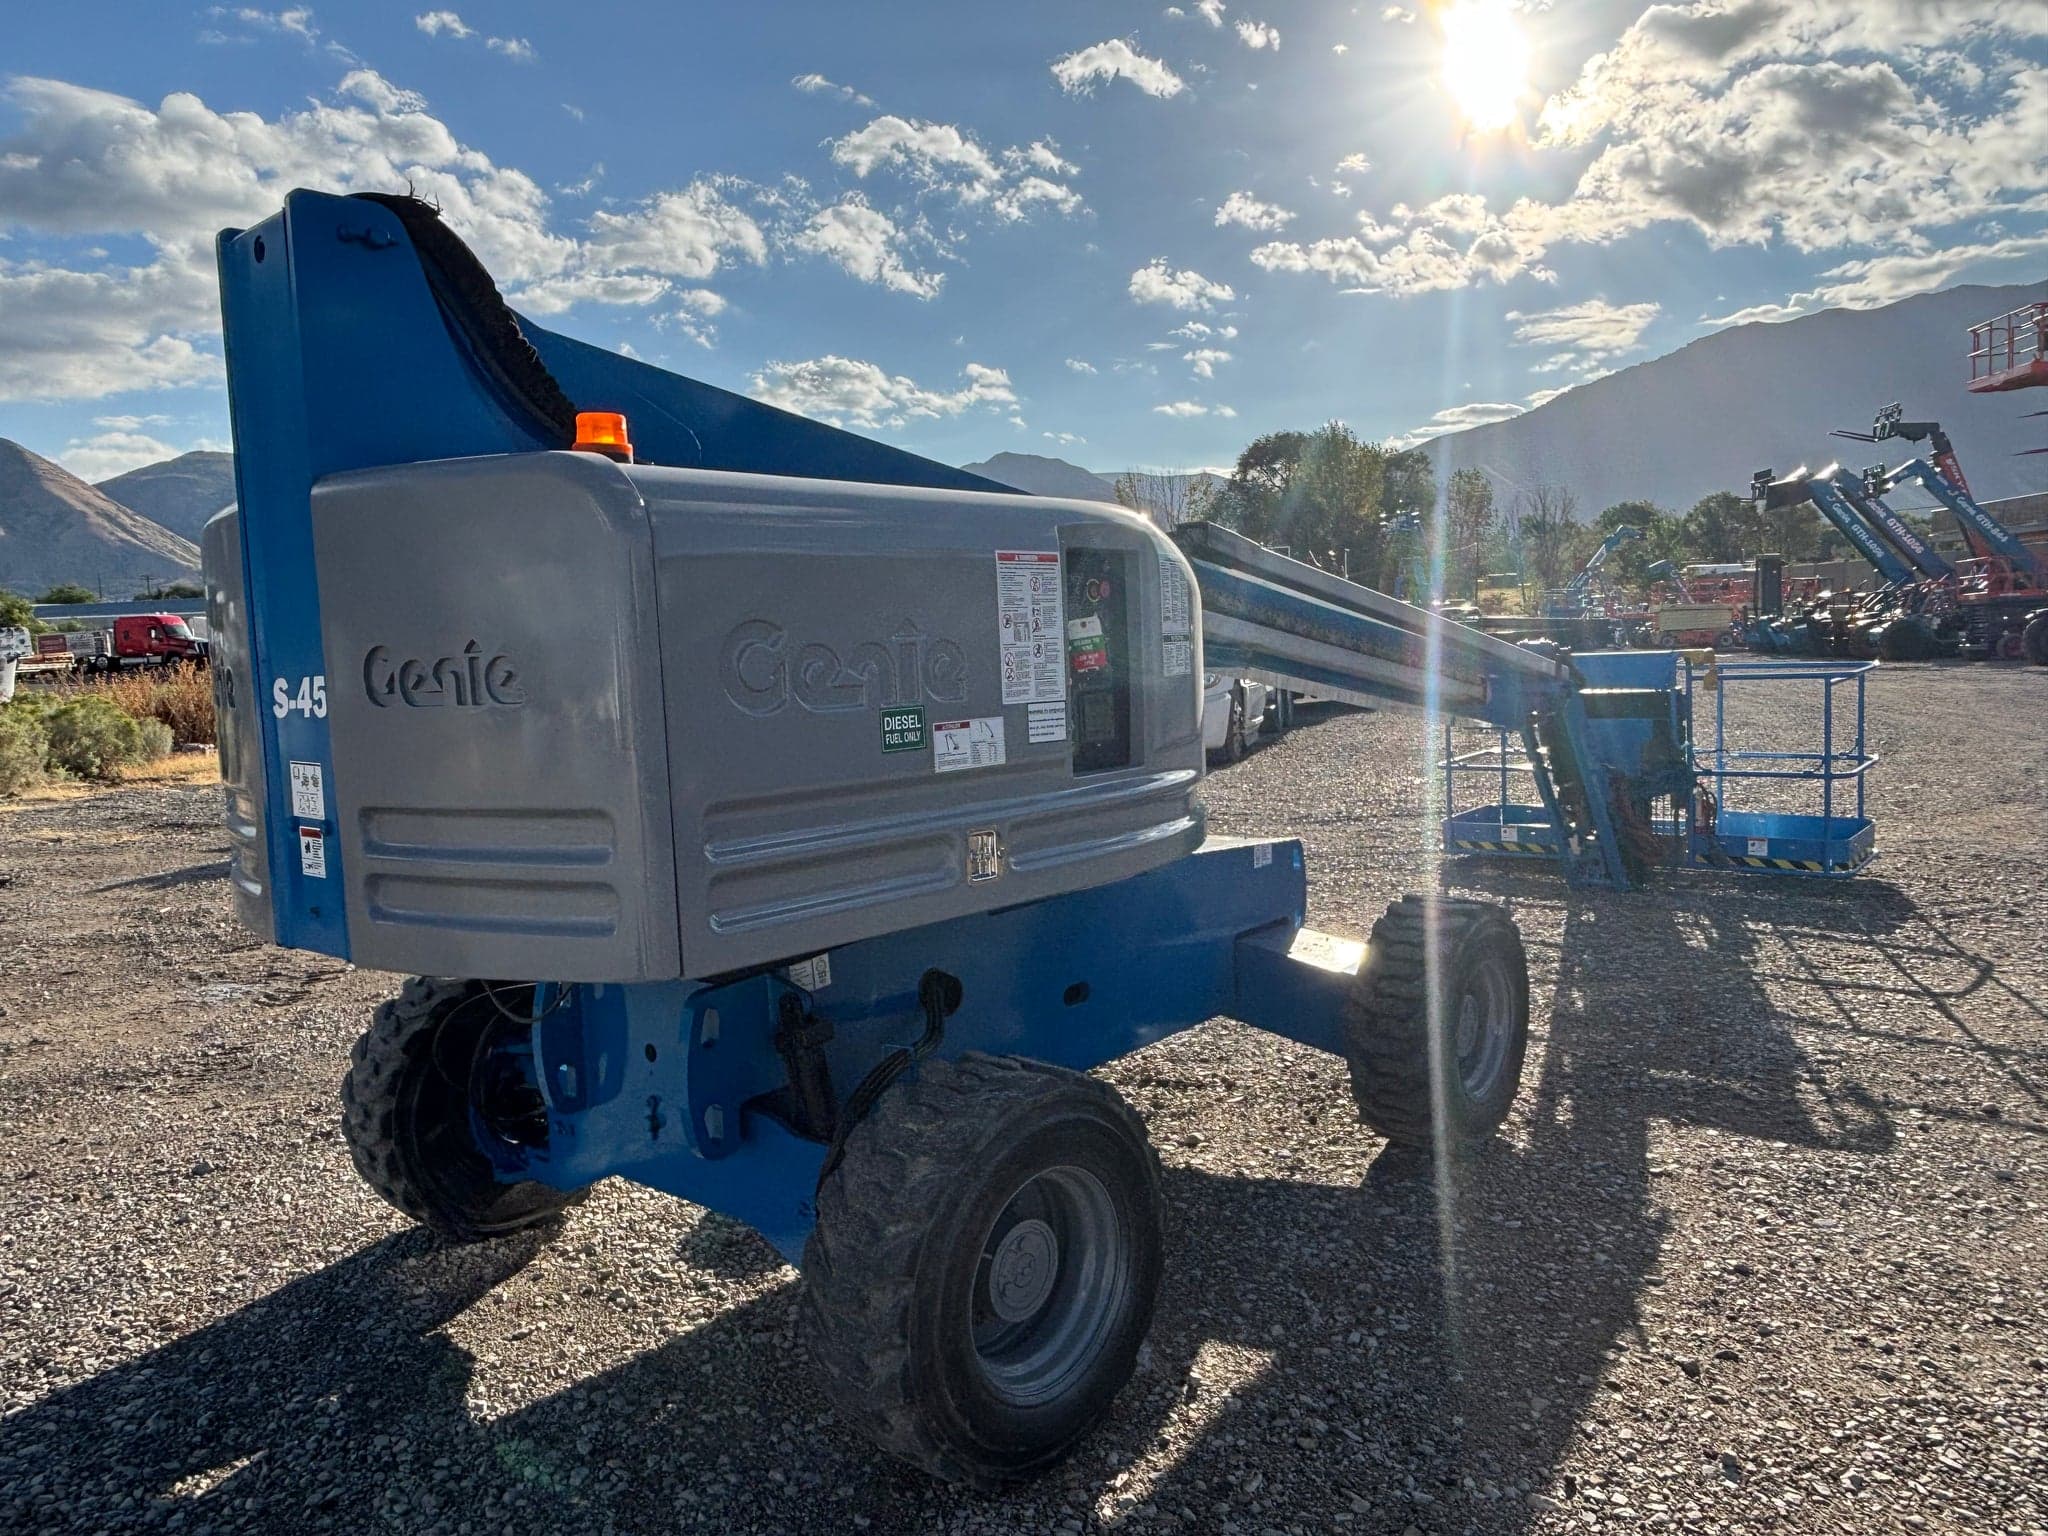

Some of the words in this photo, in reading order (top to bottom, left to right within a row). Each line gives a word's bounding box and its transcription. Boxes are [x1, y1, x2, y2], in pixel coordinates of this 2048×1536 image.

[363, 638, 527, 708] Genie
[720, 618, 967, 718] Genie
[273, 675, 327, 719] S-45
[884, 714, 922, 731] DIESEL
[885, 733, 902, 744] FUEL
[904, 731, 921, 743] ONLY
